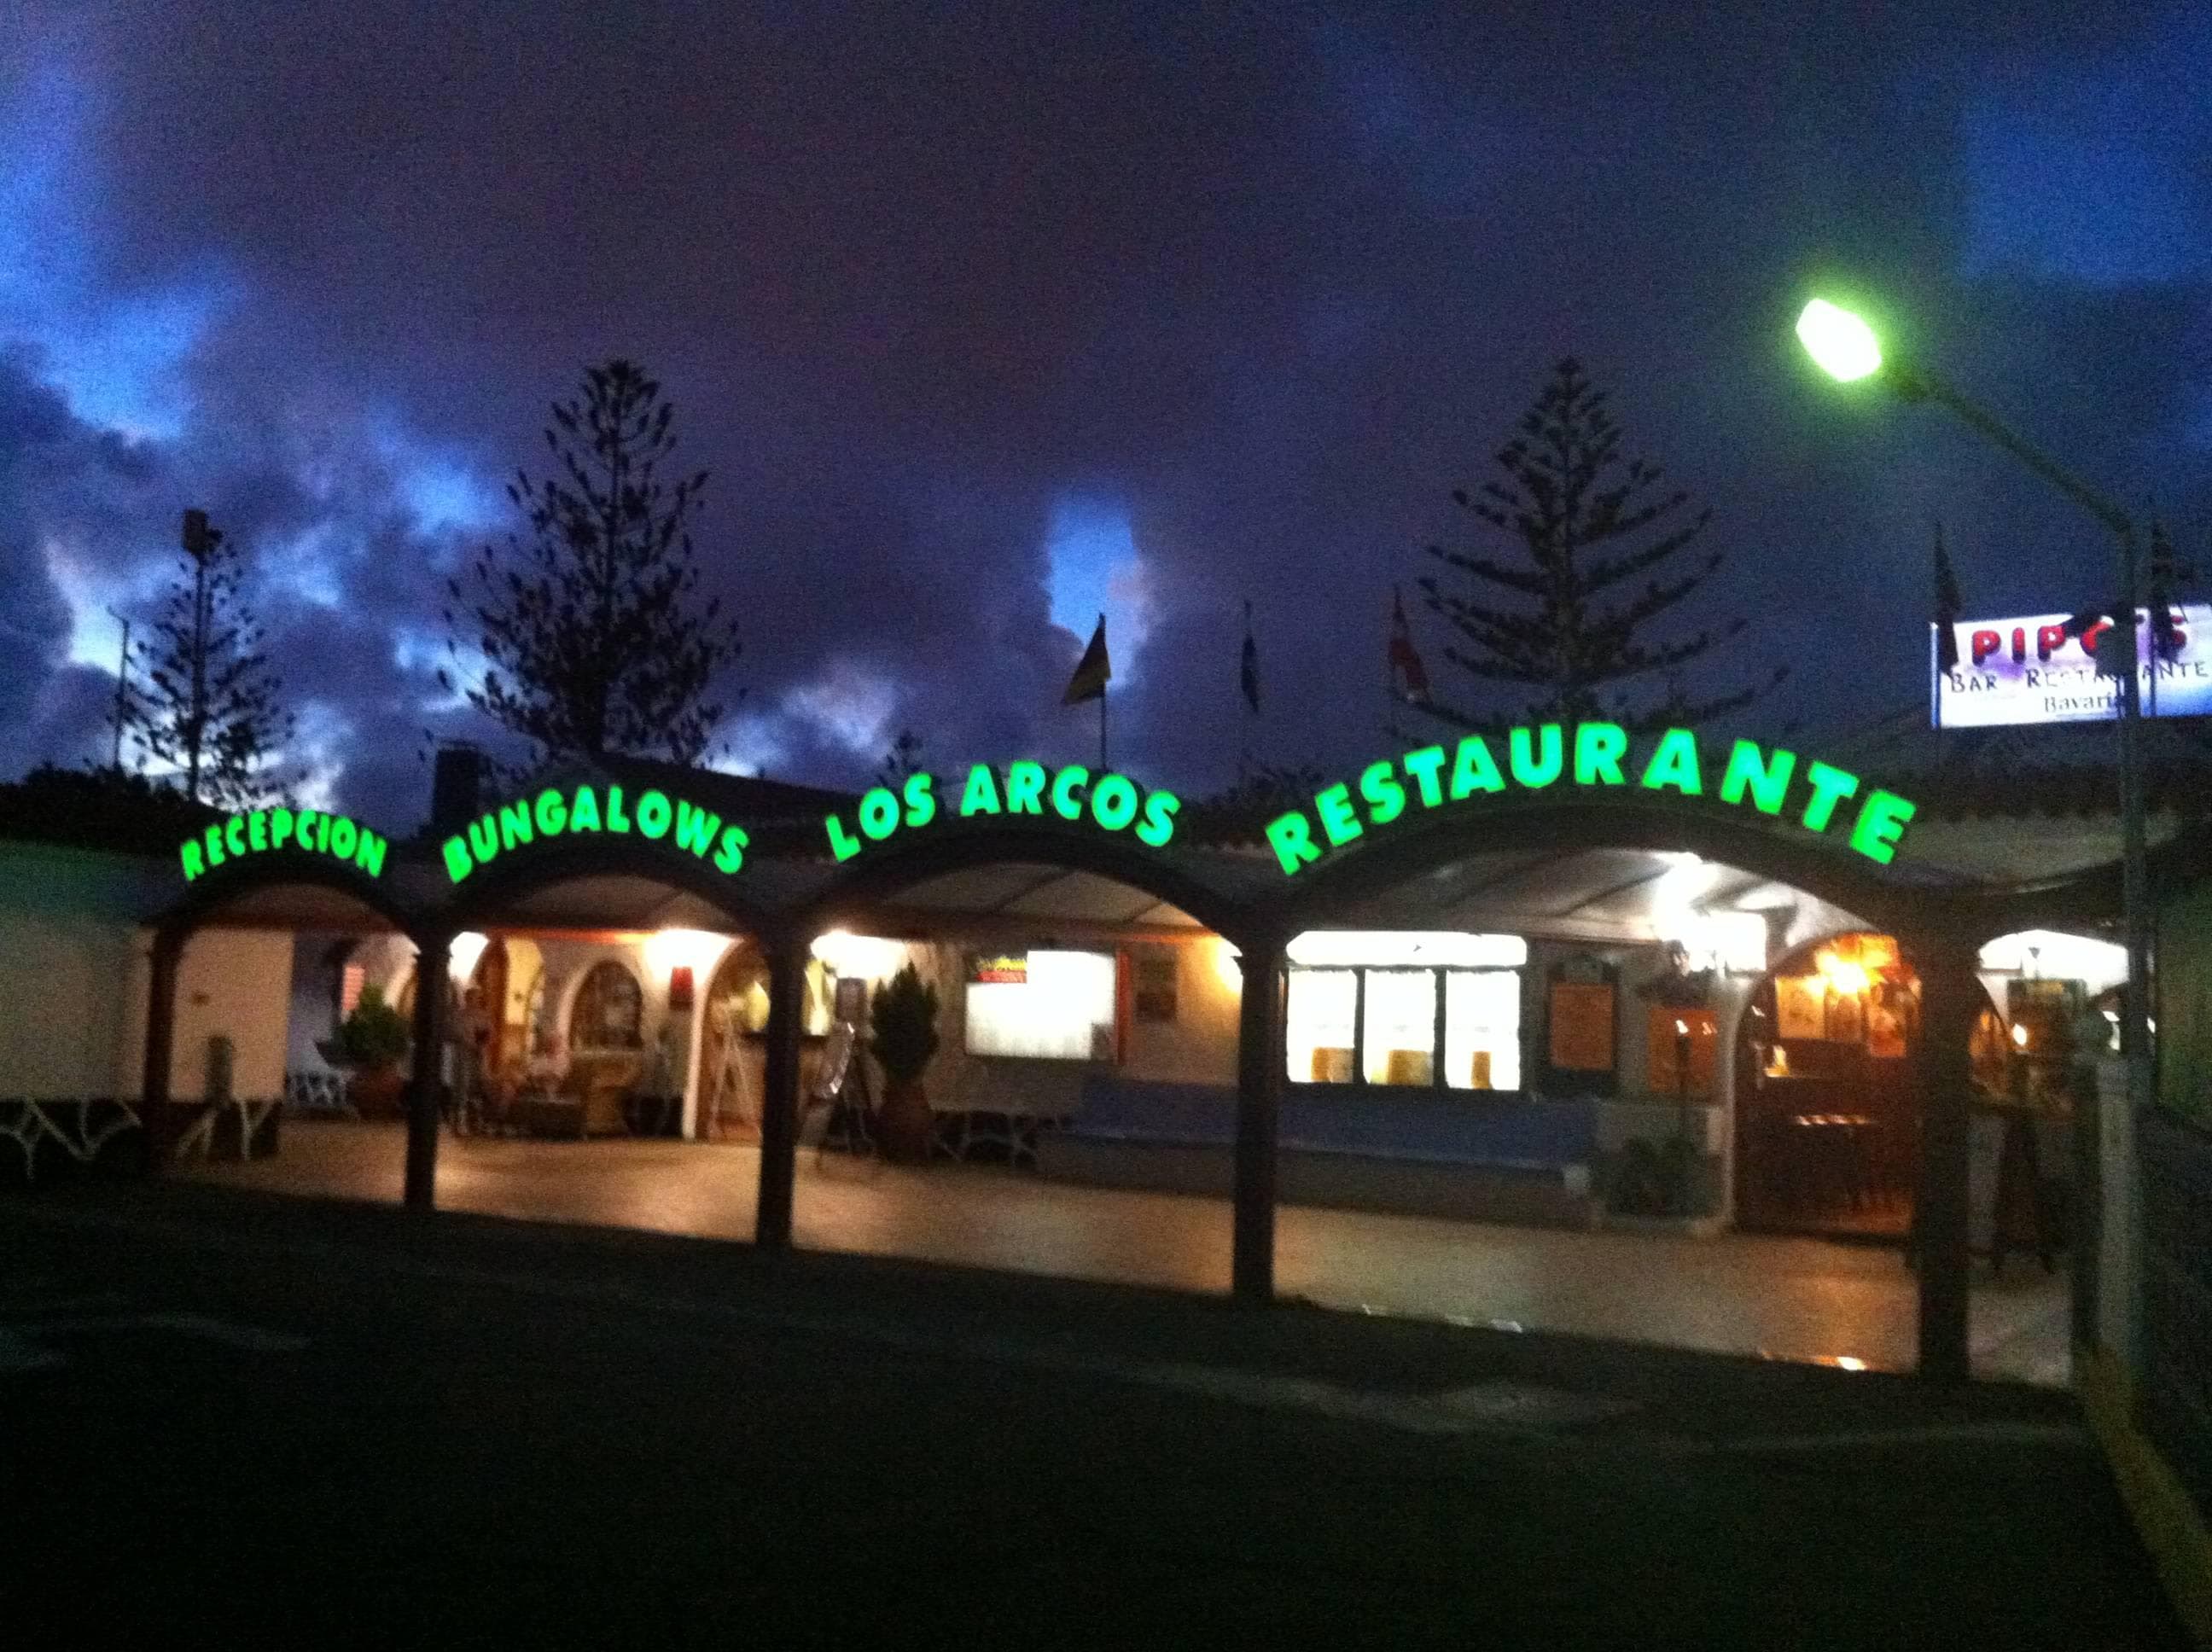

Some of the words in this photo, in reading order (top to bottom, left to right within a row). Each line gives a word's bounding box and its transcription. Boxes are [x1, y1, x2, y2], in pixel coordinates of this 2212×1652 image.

[1950, 674, 1998, 694] BAR
[2026, 660, 2209, 688] RESTANTE
[2044, 690, 2120, 713] Bavari
[442, 785, 749, 884] BUNGALOWS
[824, 772, 936, 863] LOS
[959, 759, 1181, 848] ARCOS
[1265, 721, 1917, 876] RESTAURANTE
[180, 806, 387, 881] RECEPCION
